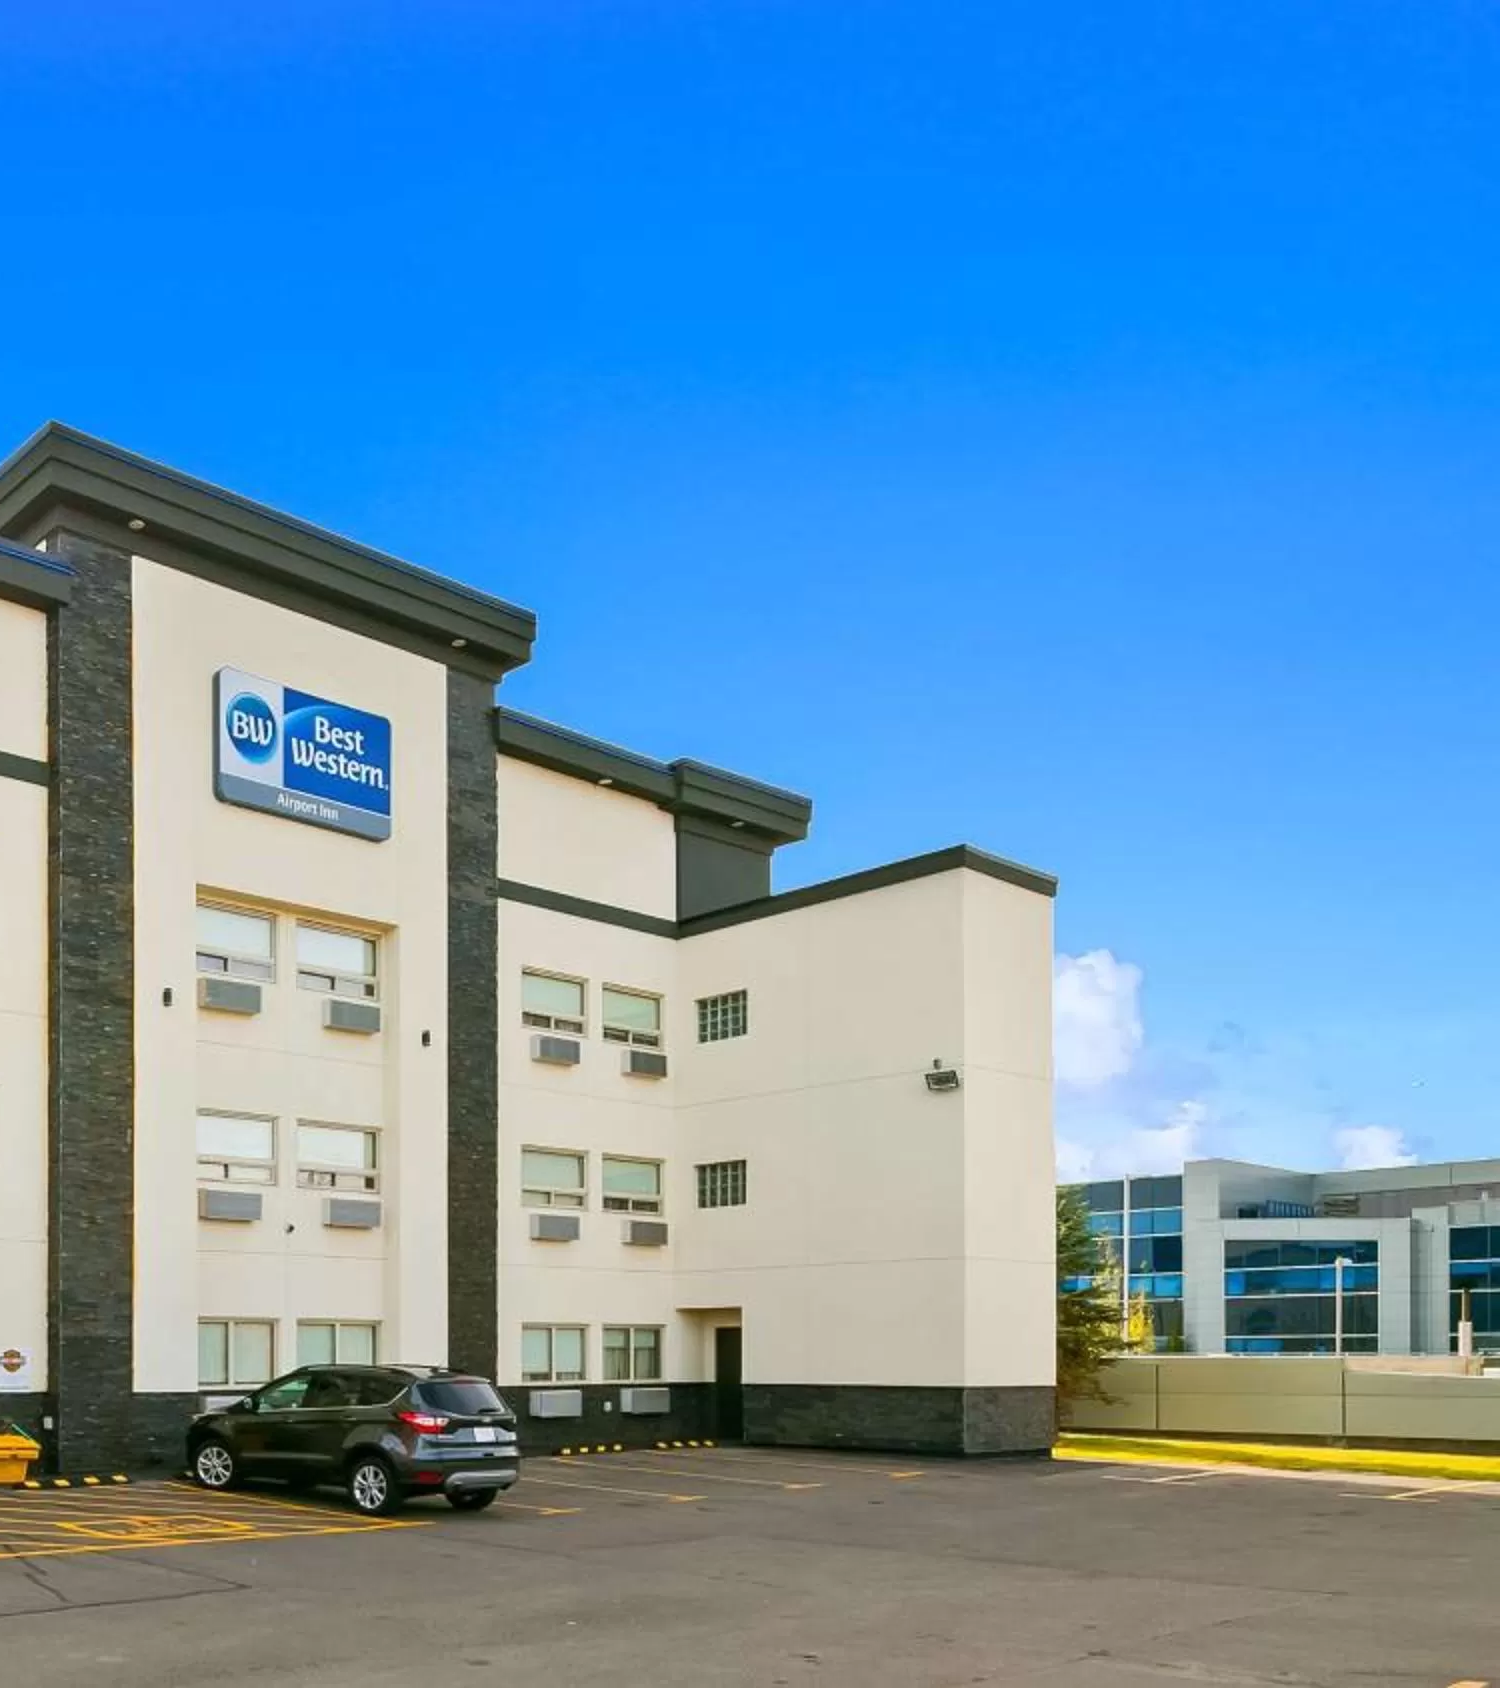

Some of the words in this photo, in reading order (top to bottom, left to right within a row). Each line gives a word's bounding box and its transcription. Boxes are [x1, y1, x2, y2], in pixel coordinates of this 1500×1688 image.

[232, 710, 273, 746] BW
[315, 715, 365, 756] Best
[277, 793, 317, 816] Airport
[320, 803, 340, 822] Inn
